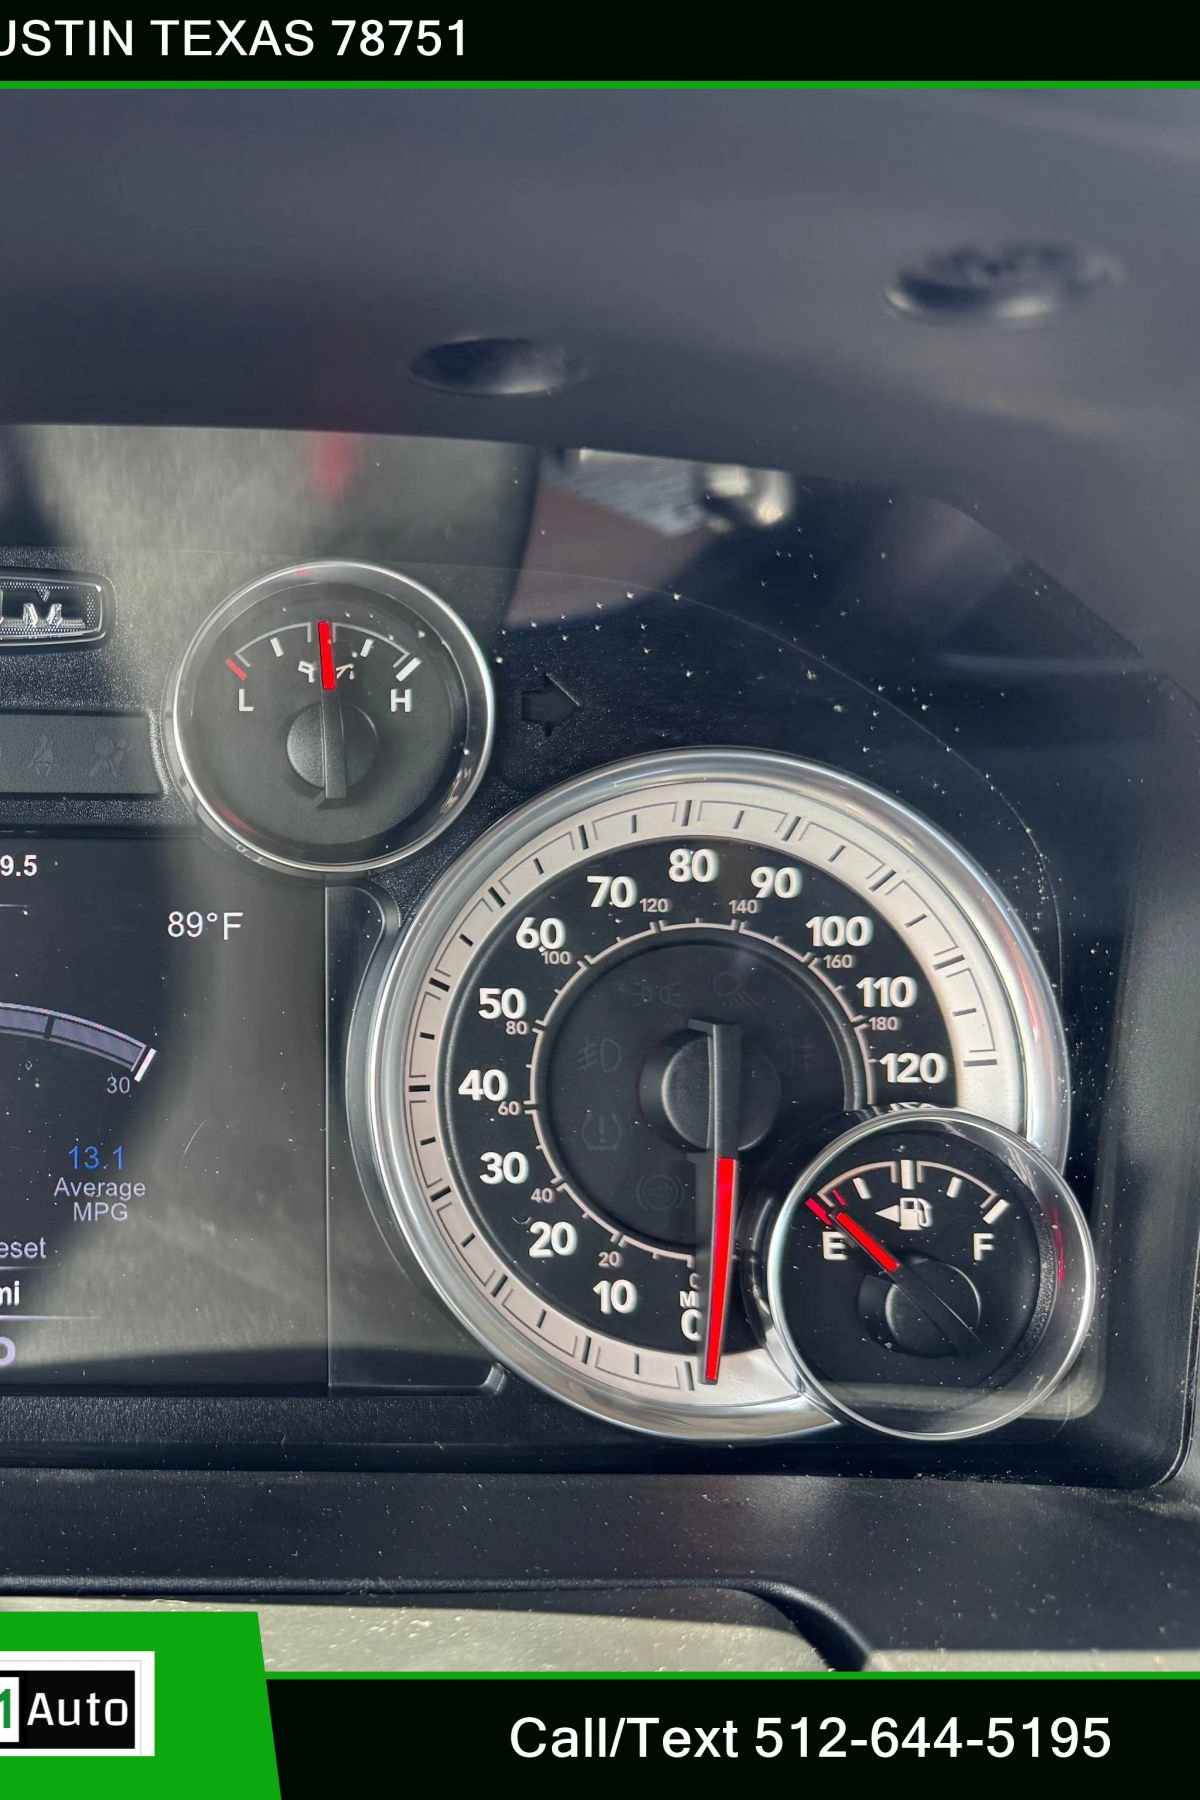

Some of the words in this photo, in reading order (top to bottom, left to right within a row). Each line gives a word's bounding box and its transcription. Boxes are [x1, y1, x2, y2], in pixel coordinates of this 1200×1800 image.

[238, 688, 254, 712] L
[390, 688, 412, 713] H
[668, 849, 718, 882] 80
[587, 876, 637, 909] 70
[750, 867, 801, 899] 90
[639, 896, 670, 915] 120
[727, 897, 759, 915] 140
[166, 911, 244, 941] 89°F
[515, 917, 566, 950] 60
[806, 915, 873, 949] 100
[540, 949, 572, 967] 100
[823, 952, 854, 971] 160
[477, 988, 528, 1021] 50
[856, 976, 918, 1010] 110
[504, 1019, 528, 1038] 80
[868, 1015, 899, 1034] 180
[878, 1053, 947, 1086] 120
[106, 1076, 130, 1094] 30
[457, 1070, 509, 1103] 40
[497, 1099, 521, 1118] 60
[68, 1147, 125, 1170] 13.1
[479, 1151, 529, 1184] 30
[53, 1177, 146, 1203] Average
[530, 1186, 555, 1205] 40
[73, 1202, 129, 1222] MPG
[528, 1221, 578, 1255] 20
[822, 1231, 846, 1261] E
[973, 1232, 995, 1261] F
[598, 1250, 621, 1268] 20
[593, 1281, 634, 1315] 10
